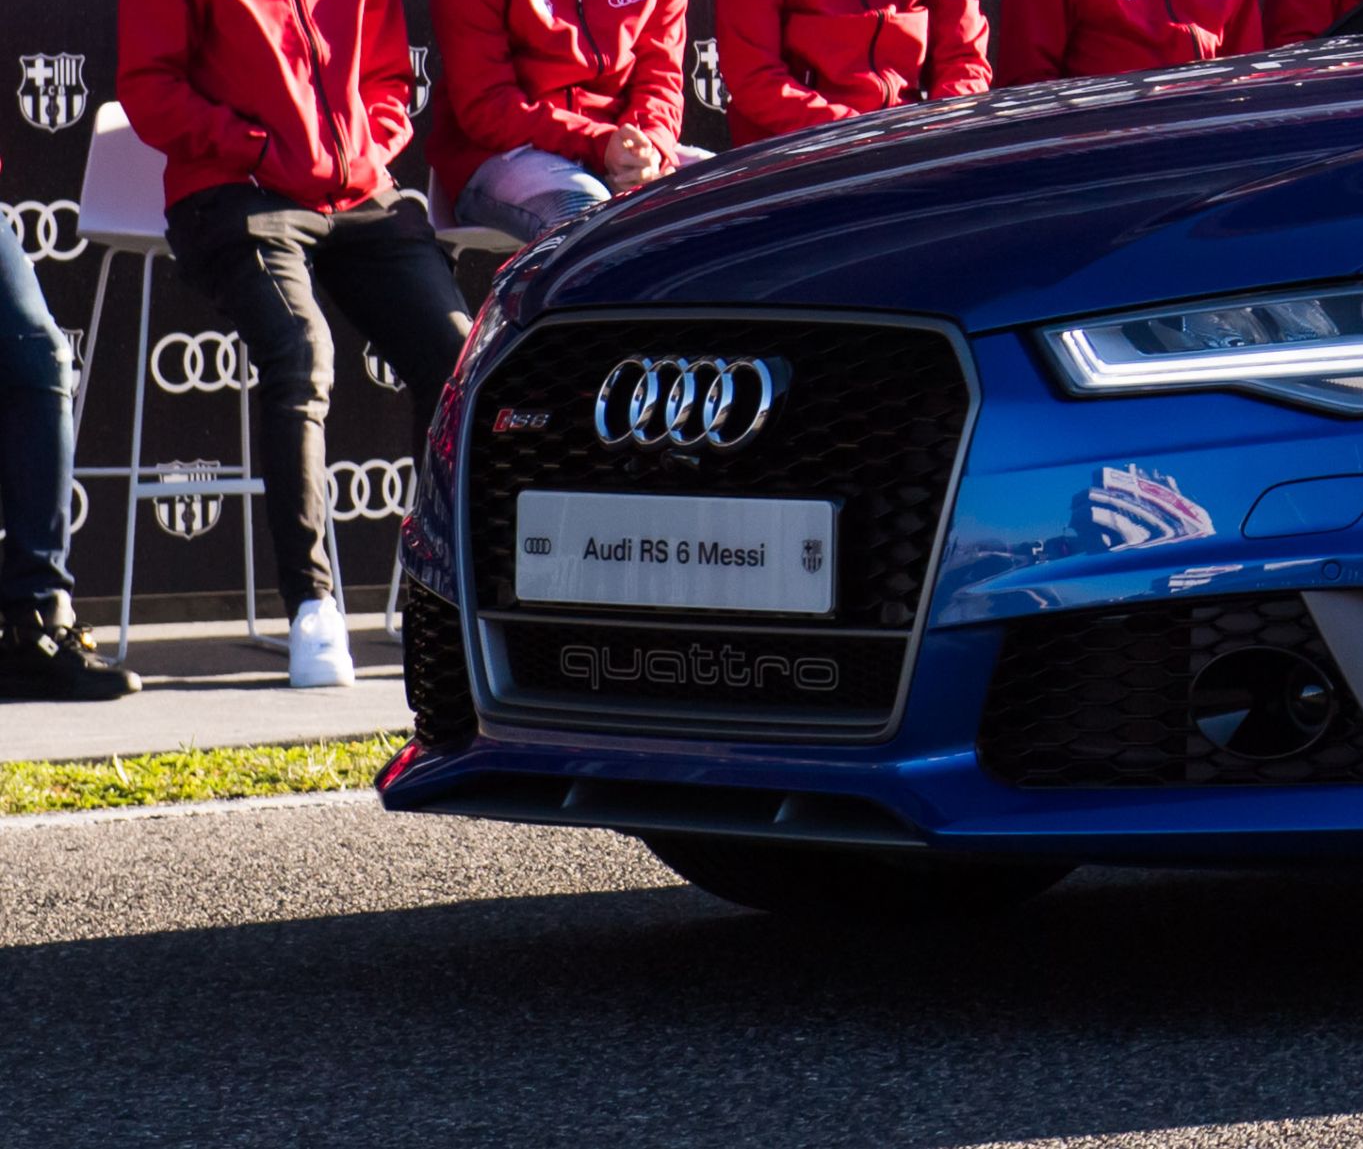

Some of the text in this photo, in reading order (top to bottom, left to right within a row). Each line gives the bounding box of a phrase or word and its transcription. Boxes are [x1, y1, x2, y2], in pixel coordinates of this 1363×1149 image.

[583, 537, 765, 567] Audi RS 6 Messi
[560, 643, 839, 691] quattro
